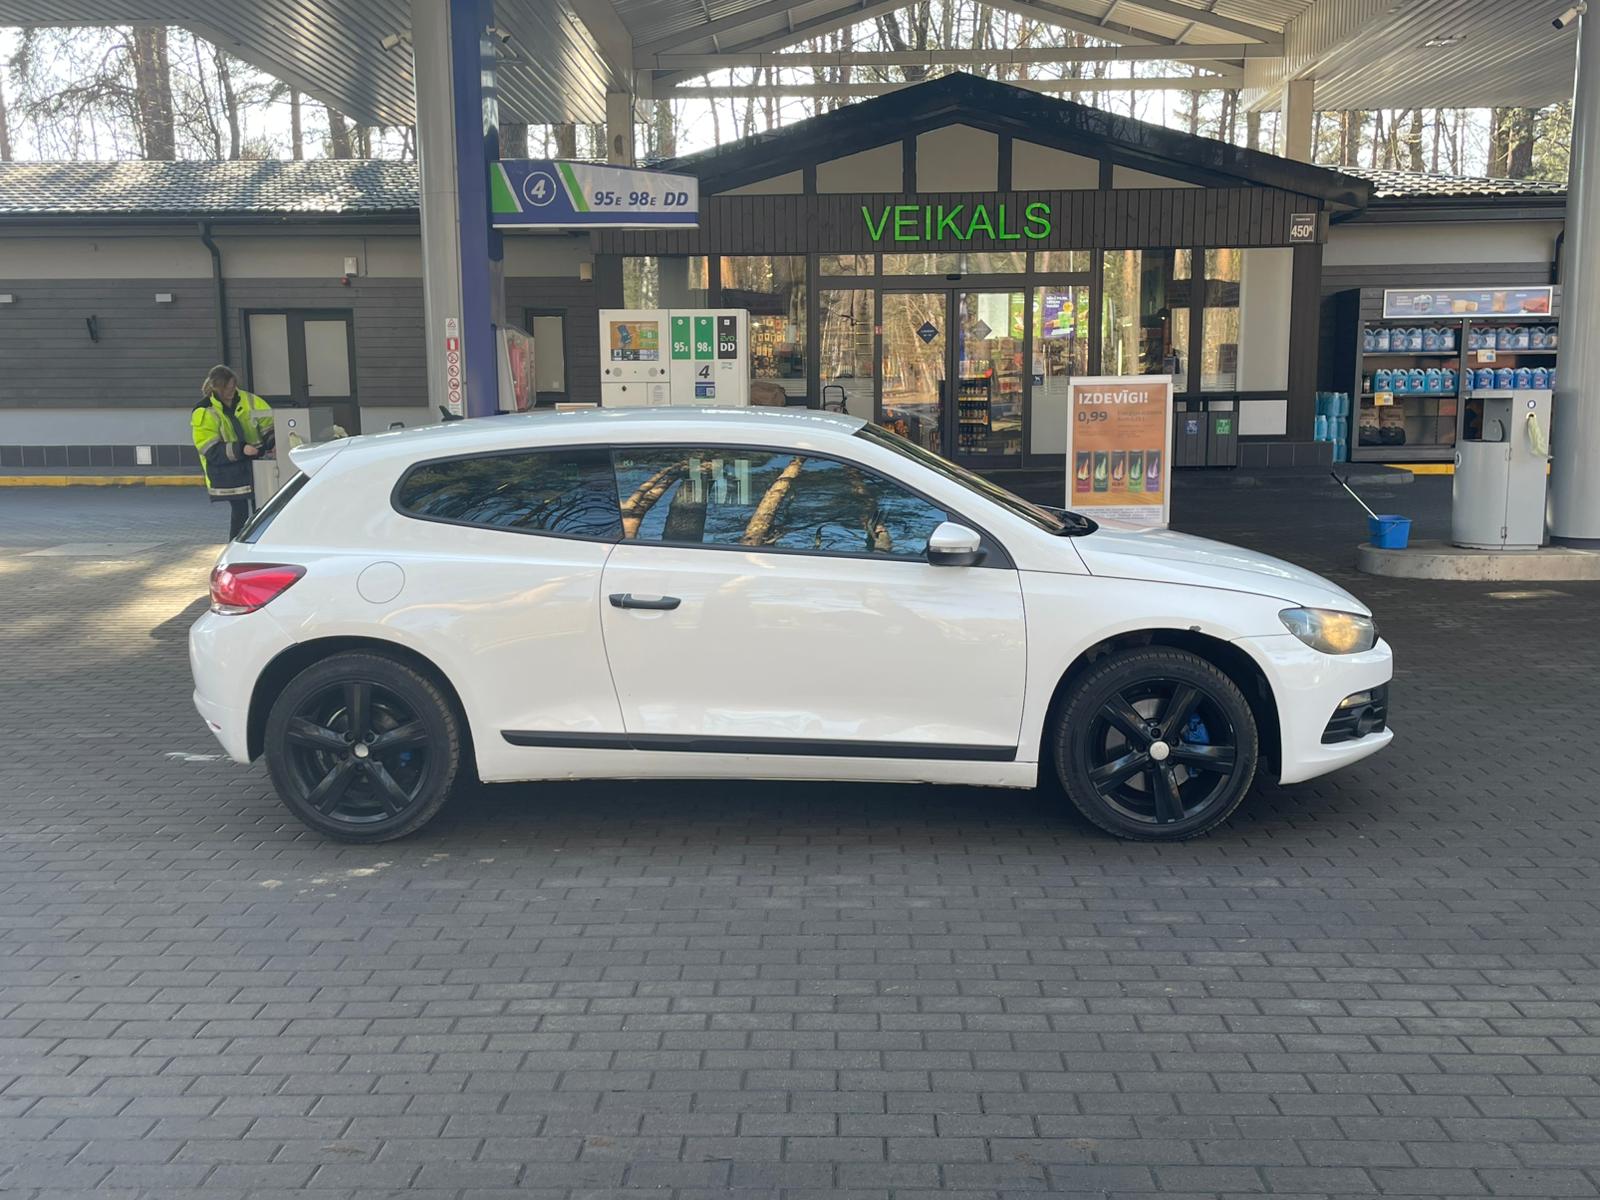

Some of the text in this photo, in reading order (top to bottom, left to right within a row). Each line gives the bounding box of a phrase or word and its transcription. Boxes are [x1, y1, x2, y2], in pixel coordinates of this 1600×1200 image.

[532, 180, 546, 198] 4
[594, 191, 689, 206] 95E 98E DD
[862, 202, 1052, 241] VEIKALS
[720, 343, 735, 352] DD
[699, 365, 710, 379] 4
[1079, 390, 1148, 404] IZDEVĪGI!
[1078, 411, 1108, 424] 0,99
